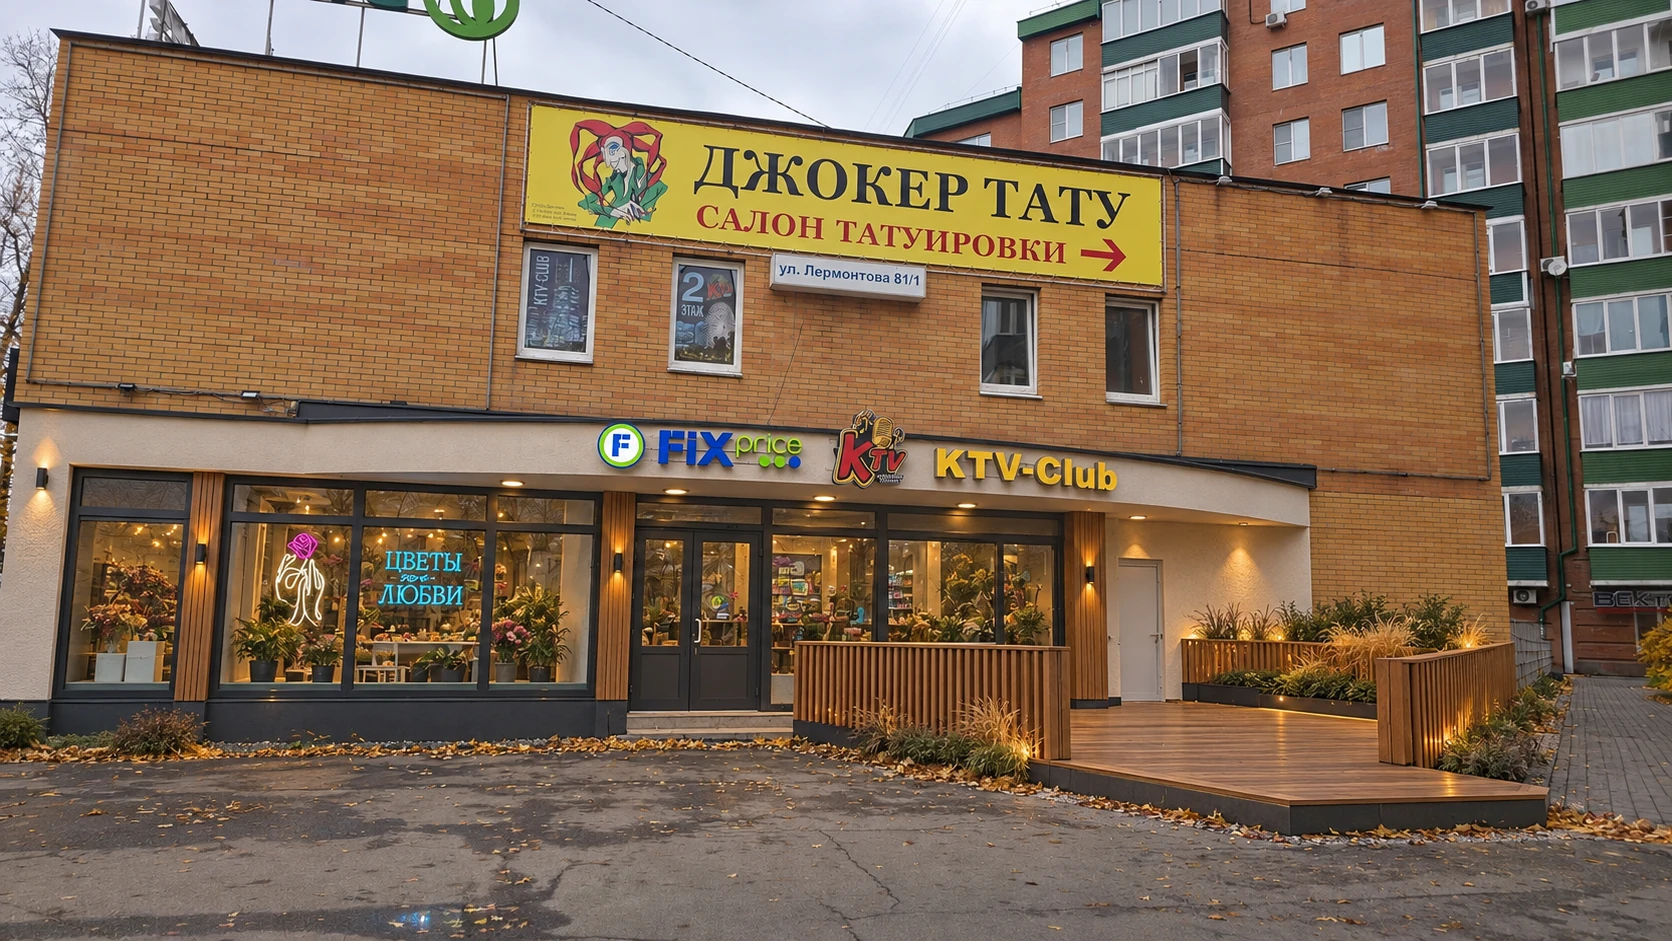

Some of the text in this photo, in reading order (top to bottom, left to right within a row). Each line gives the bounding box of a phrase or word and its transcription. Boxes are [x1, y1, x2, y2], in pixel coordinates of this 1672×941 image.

[693, 144, 1131, 230] ДЖОКЕР ТАТУ
[696, 204, 1067, 264] САЛОН ТАТУИРОВКИ
[681, 271, 705, 303] 2
[779, 264, 920, 287] ул. Лермонтова 81/1
[611, 433, 631, 457] F
[735, 433, 803, 459] price
[836, 430, 908, 484] KTV
[934, 447, 1118, 491] KTV-Club
[385, 550, 463, 573] ЦВЕТЫ
[377, 583, 464, 606] ЛЮБВИ
